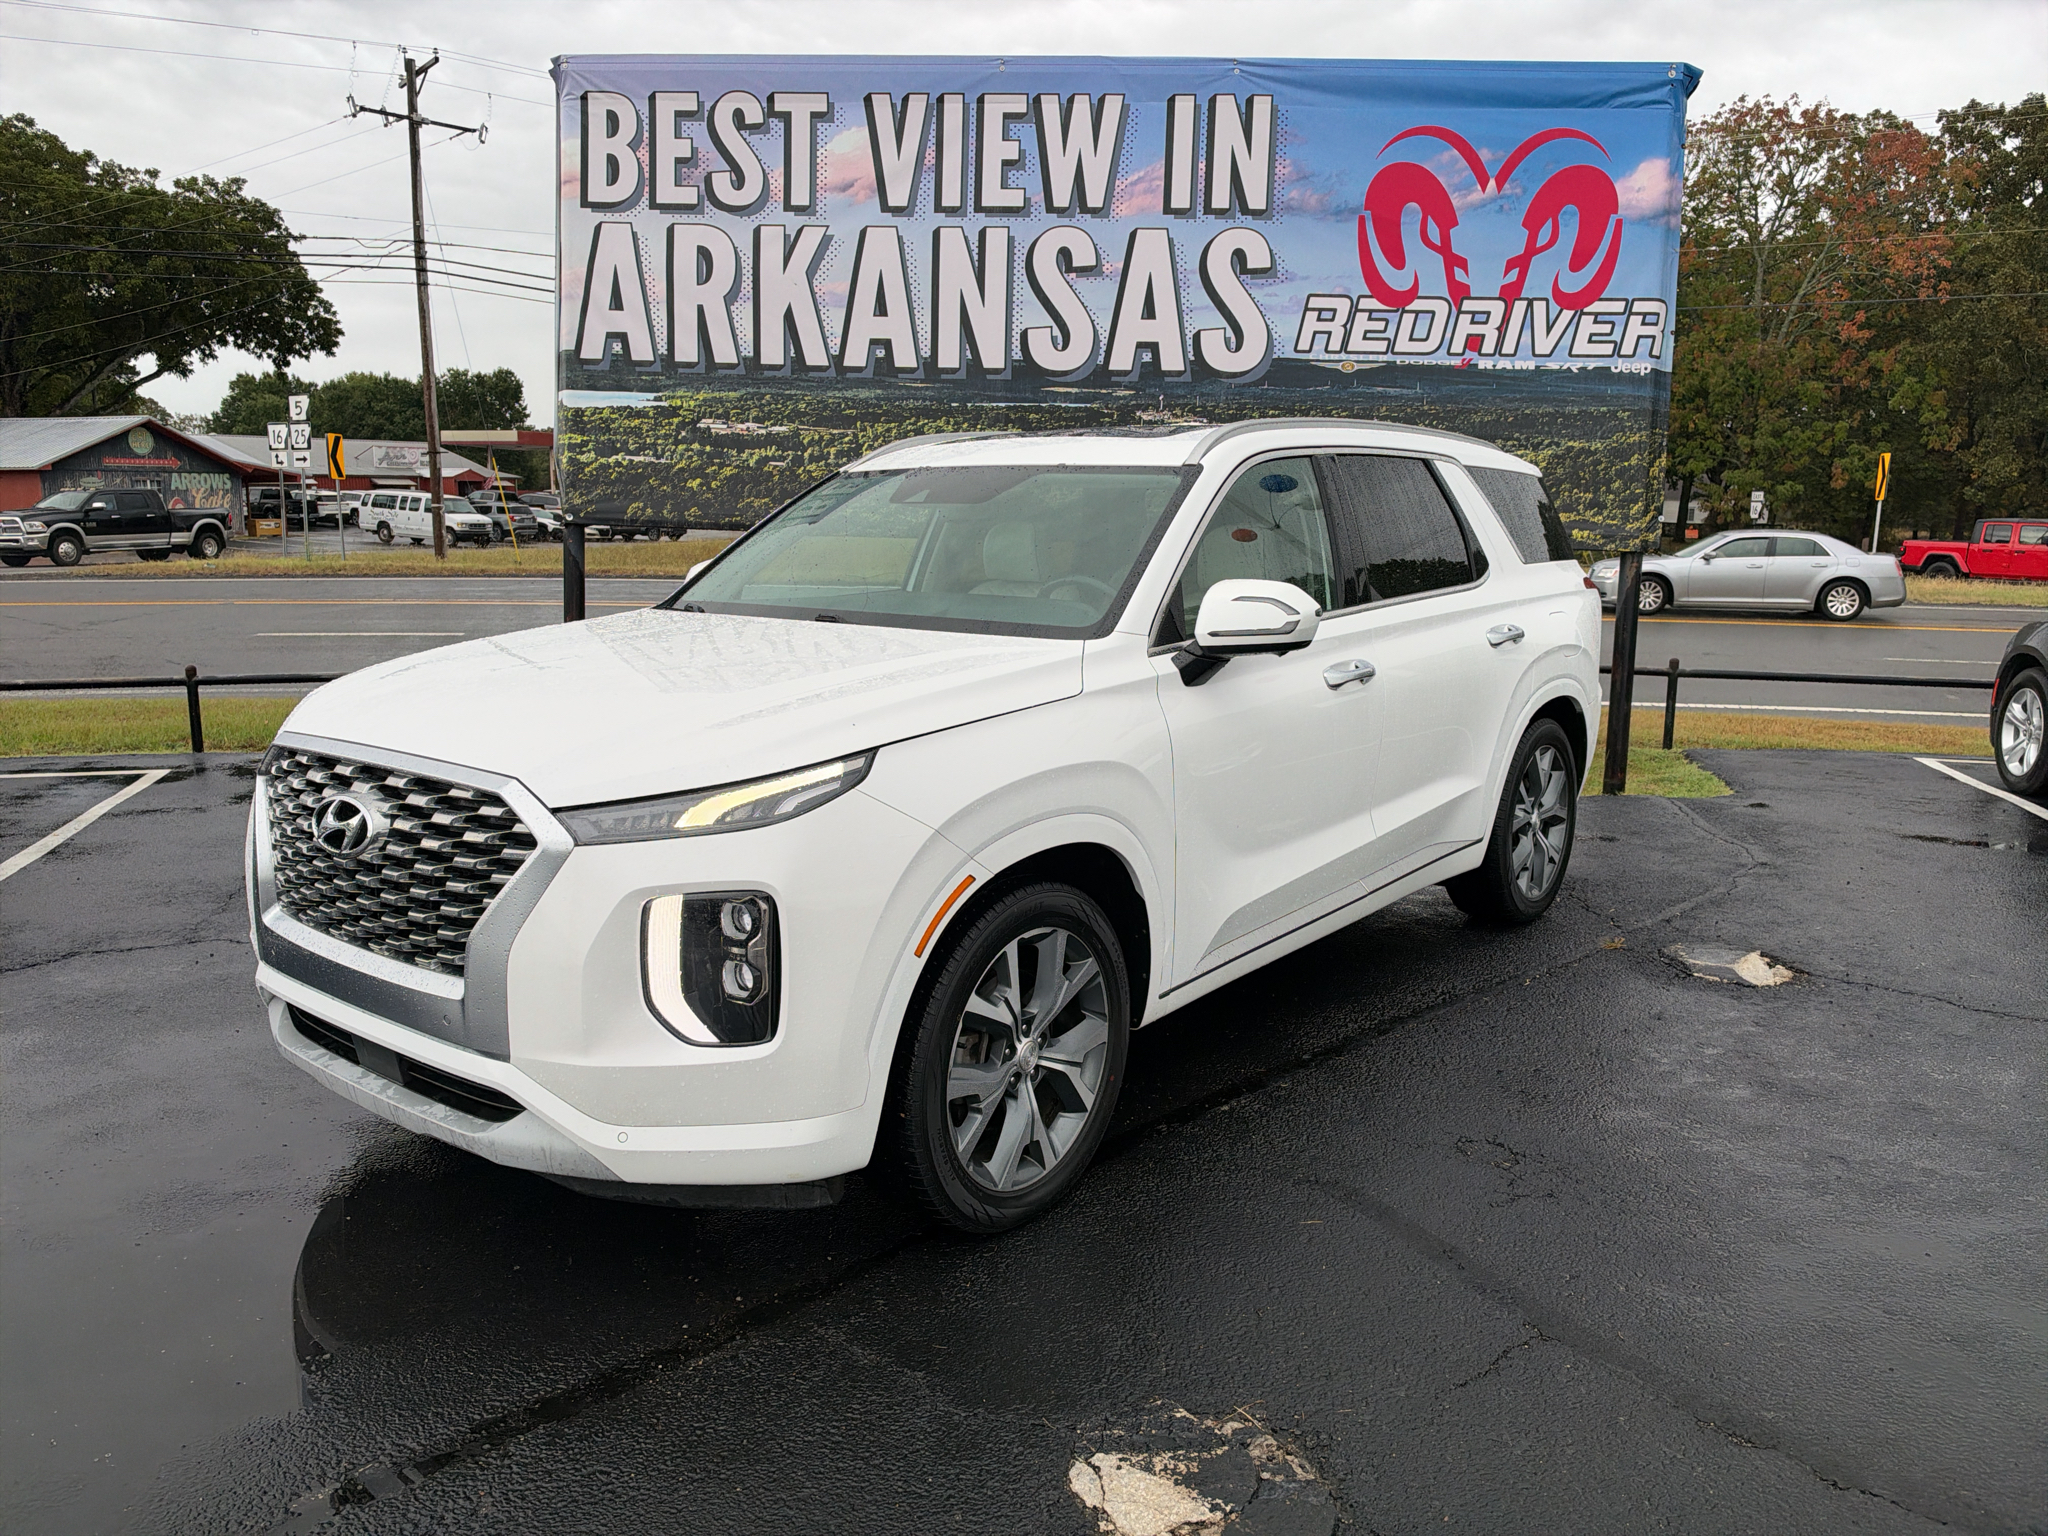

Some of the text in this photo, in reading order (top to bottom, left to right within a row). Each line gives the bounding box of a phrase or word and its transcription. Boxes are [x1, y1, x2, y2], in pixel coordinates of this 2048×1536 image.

[580, 90, 1274, 217] BEST VIEW IN
[575, 220, 1275, 378] ARKANSAS
[1477, 359, 1536, 370] RAM
[1611, 359, 1652, 377] Jeep
[294, 400, 303, 416] 5
[272, 429, 283, 445] 16
[294, 429, 307, 445] 25
[170, 472, 233, 491] ARROWS
[1752, 504, 1758, 516] 16
